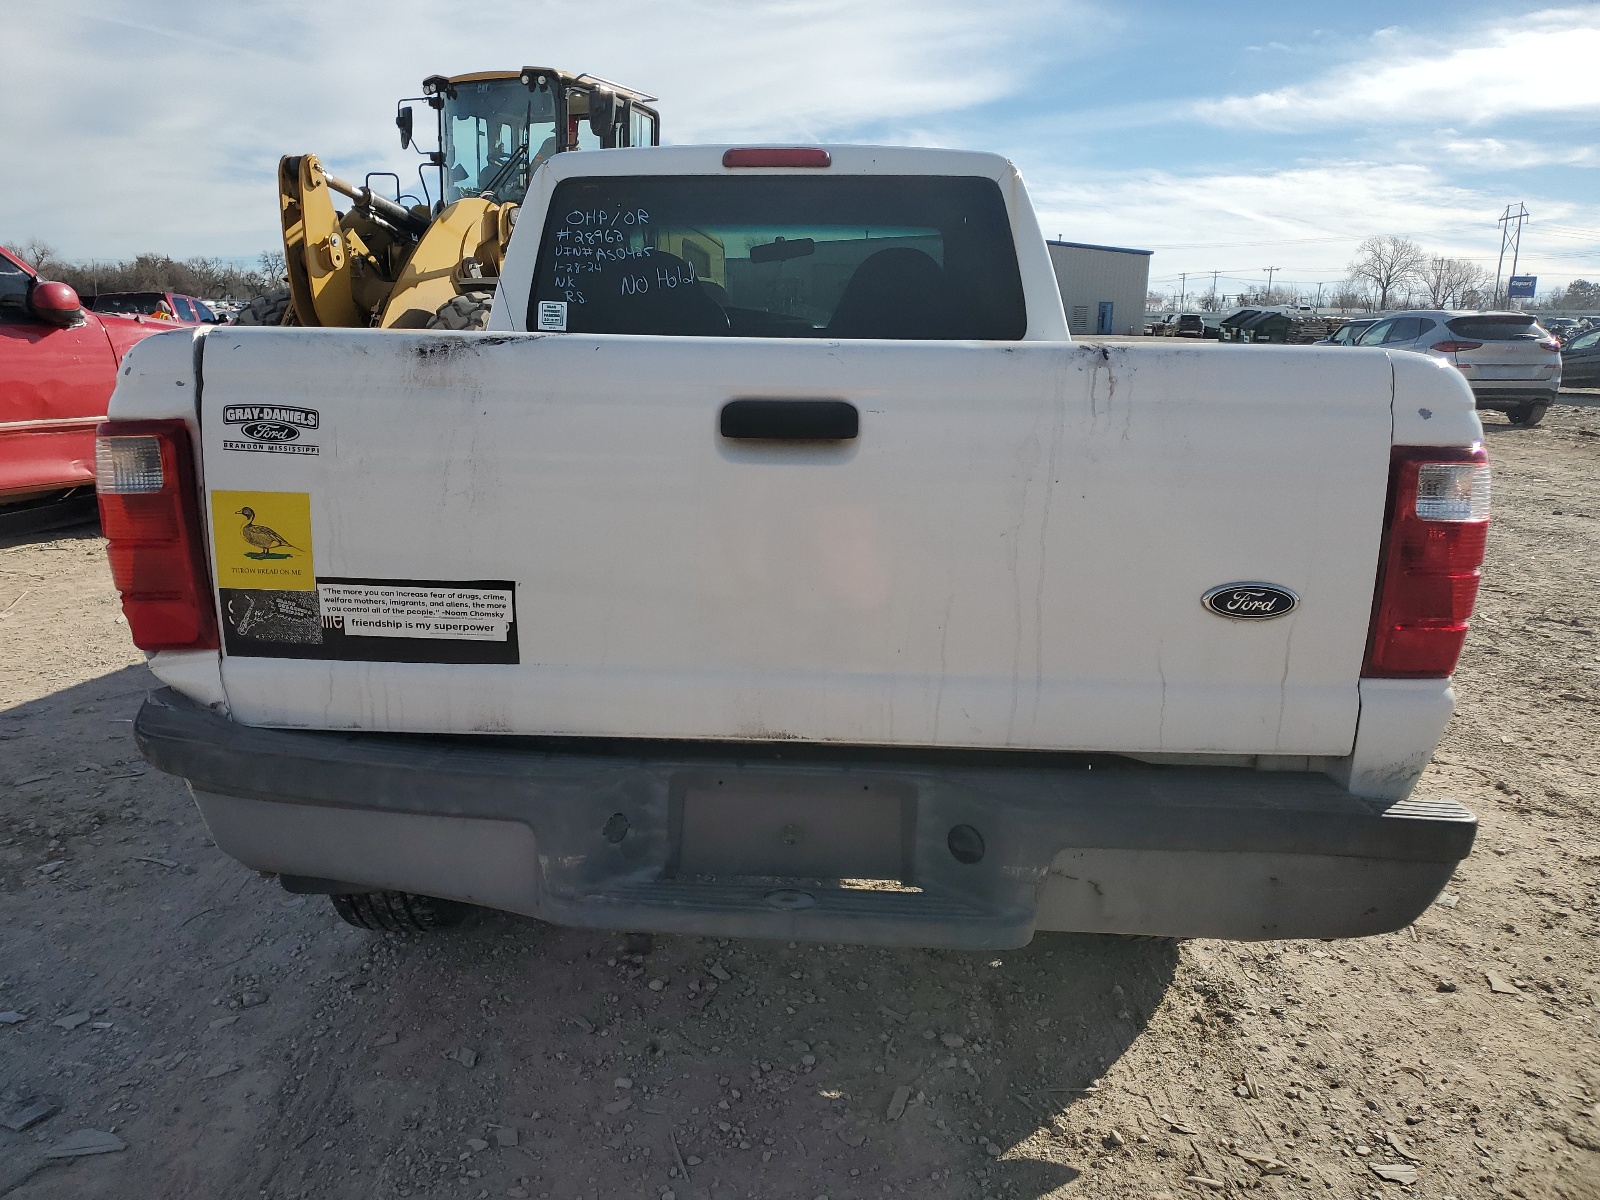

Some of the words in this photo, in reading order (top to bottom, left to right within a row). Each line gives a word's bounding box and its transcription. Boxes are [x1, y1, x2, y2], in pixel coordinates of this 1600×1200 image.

[226, 407, 316, 426] GRAY-DANIELS
[254, 423, 289, 439] Ford
[223, 442, 264, 450] BRANDON
[267, 445, 319, 454] MISSISSIPPI
[396, 590, 428, 598] increase
[354, 598, 388, 606] mothers,
[389, 599, 428, 607] imigrants,
[1226, 591, 1278, 611] Ford
[469, 610, 505, 618] Chomsky
[351, 618, 403, 629] friendship
[405, 620, 413, 629] is
[416, 622, 431, 631] my
[434, 623, 495, 632] superpower
